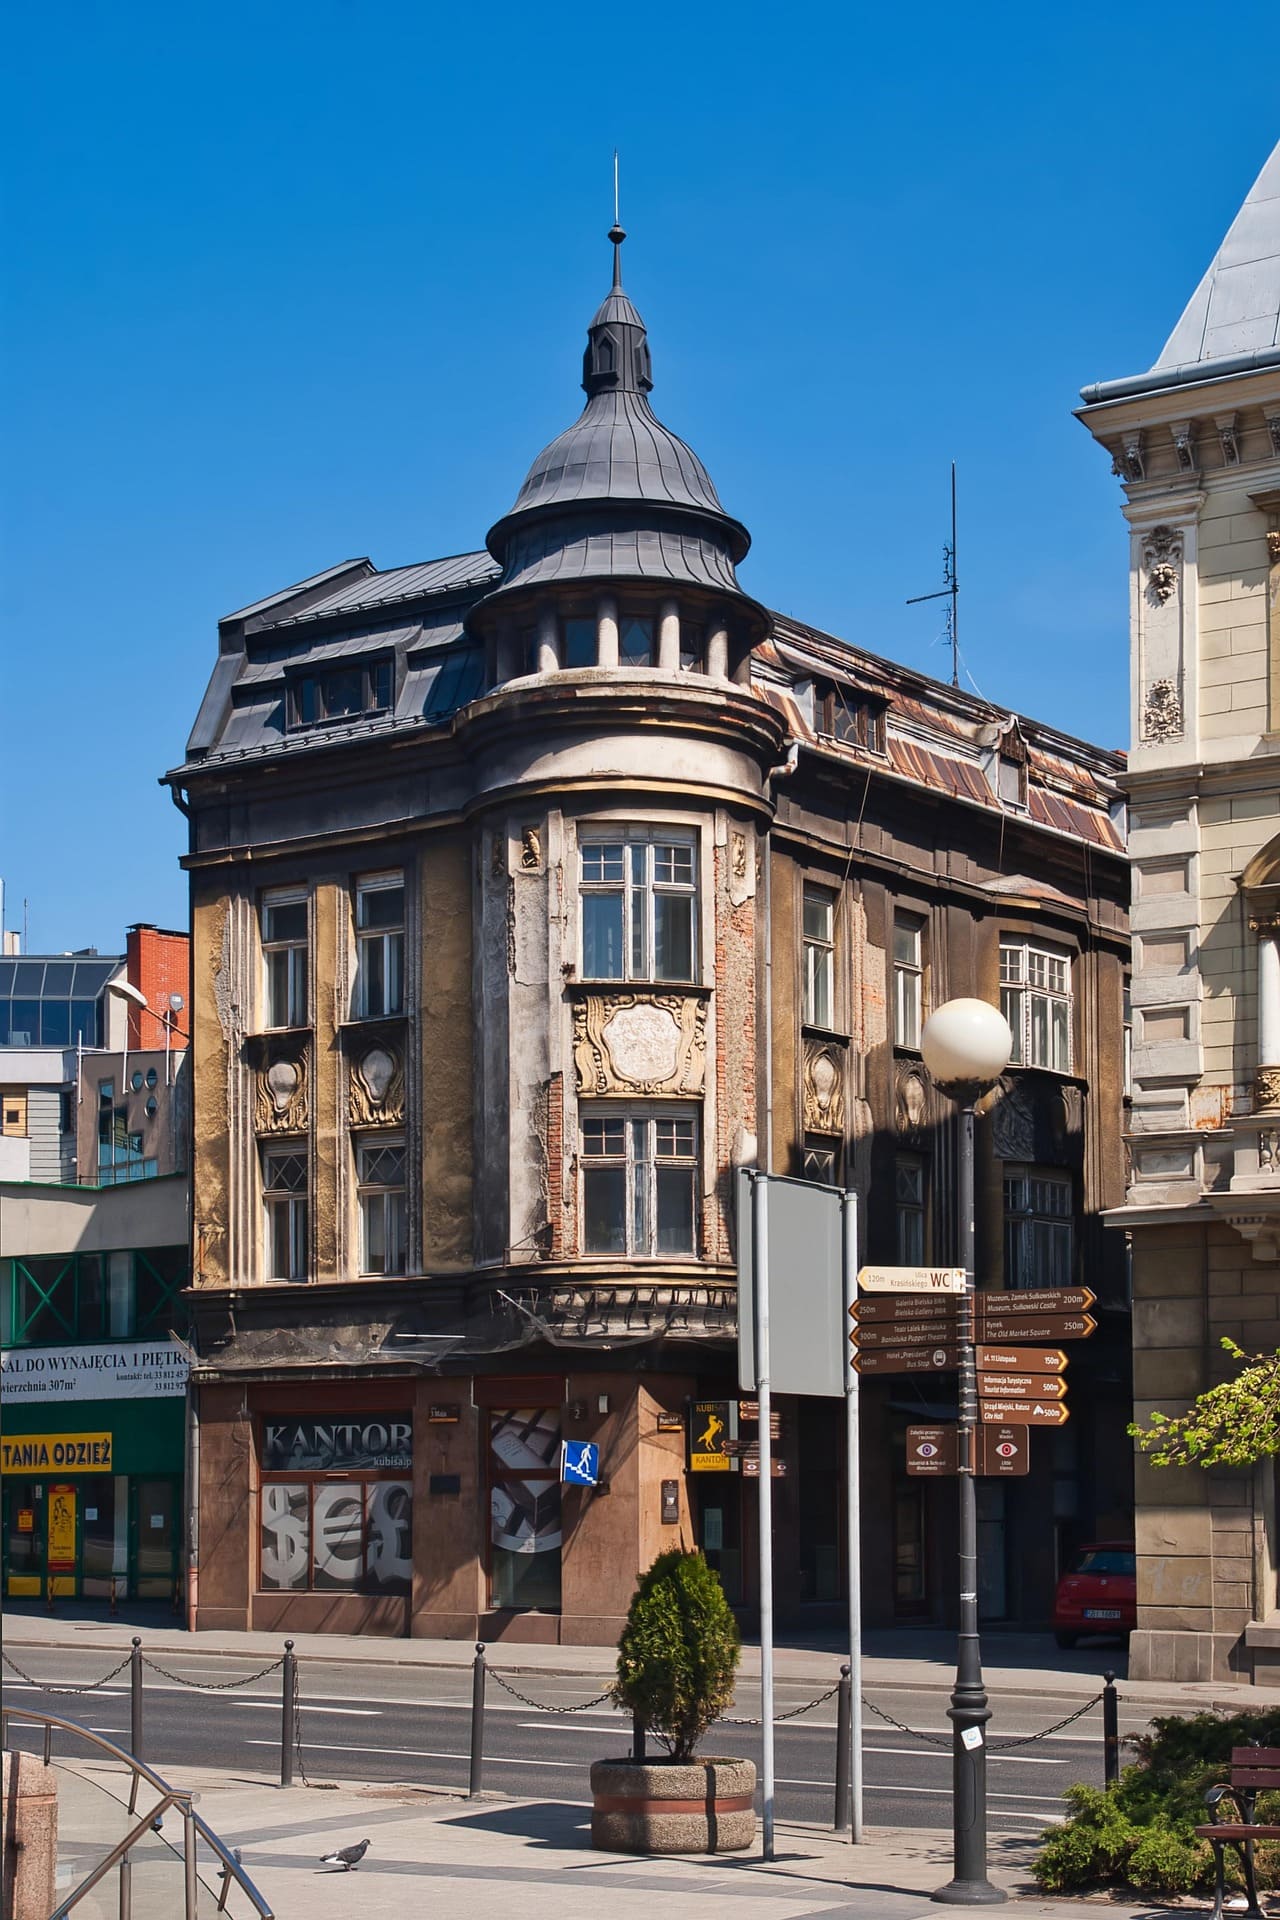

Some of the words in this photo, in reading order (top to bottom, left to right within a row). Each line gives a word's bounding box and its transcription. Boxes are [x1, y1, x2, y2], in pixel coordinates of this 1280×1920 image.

[930, 1272, 950, 1288] WC
[1064, 1296, 1083, 1304] 200m
[859, 1306, 876, 1314] 250m
[1064, 1322, 1084, 1330] 250m
[1030, 1329, 1051, 1337] Square
[26, 1358, 44, 1372] DO
[50, 1353, 126, 1372] WYNAJĘCIA
[1044, 1409, 1060, 1417] 500m
[266, 1424, 412, 1452] KANTOR
[3, 1444, 49, 1467] TANIA
